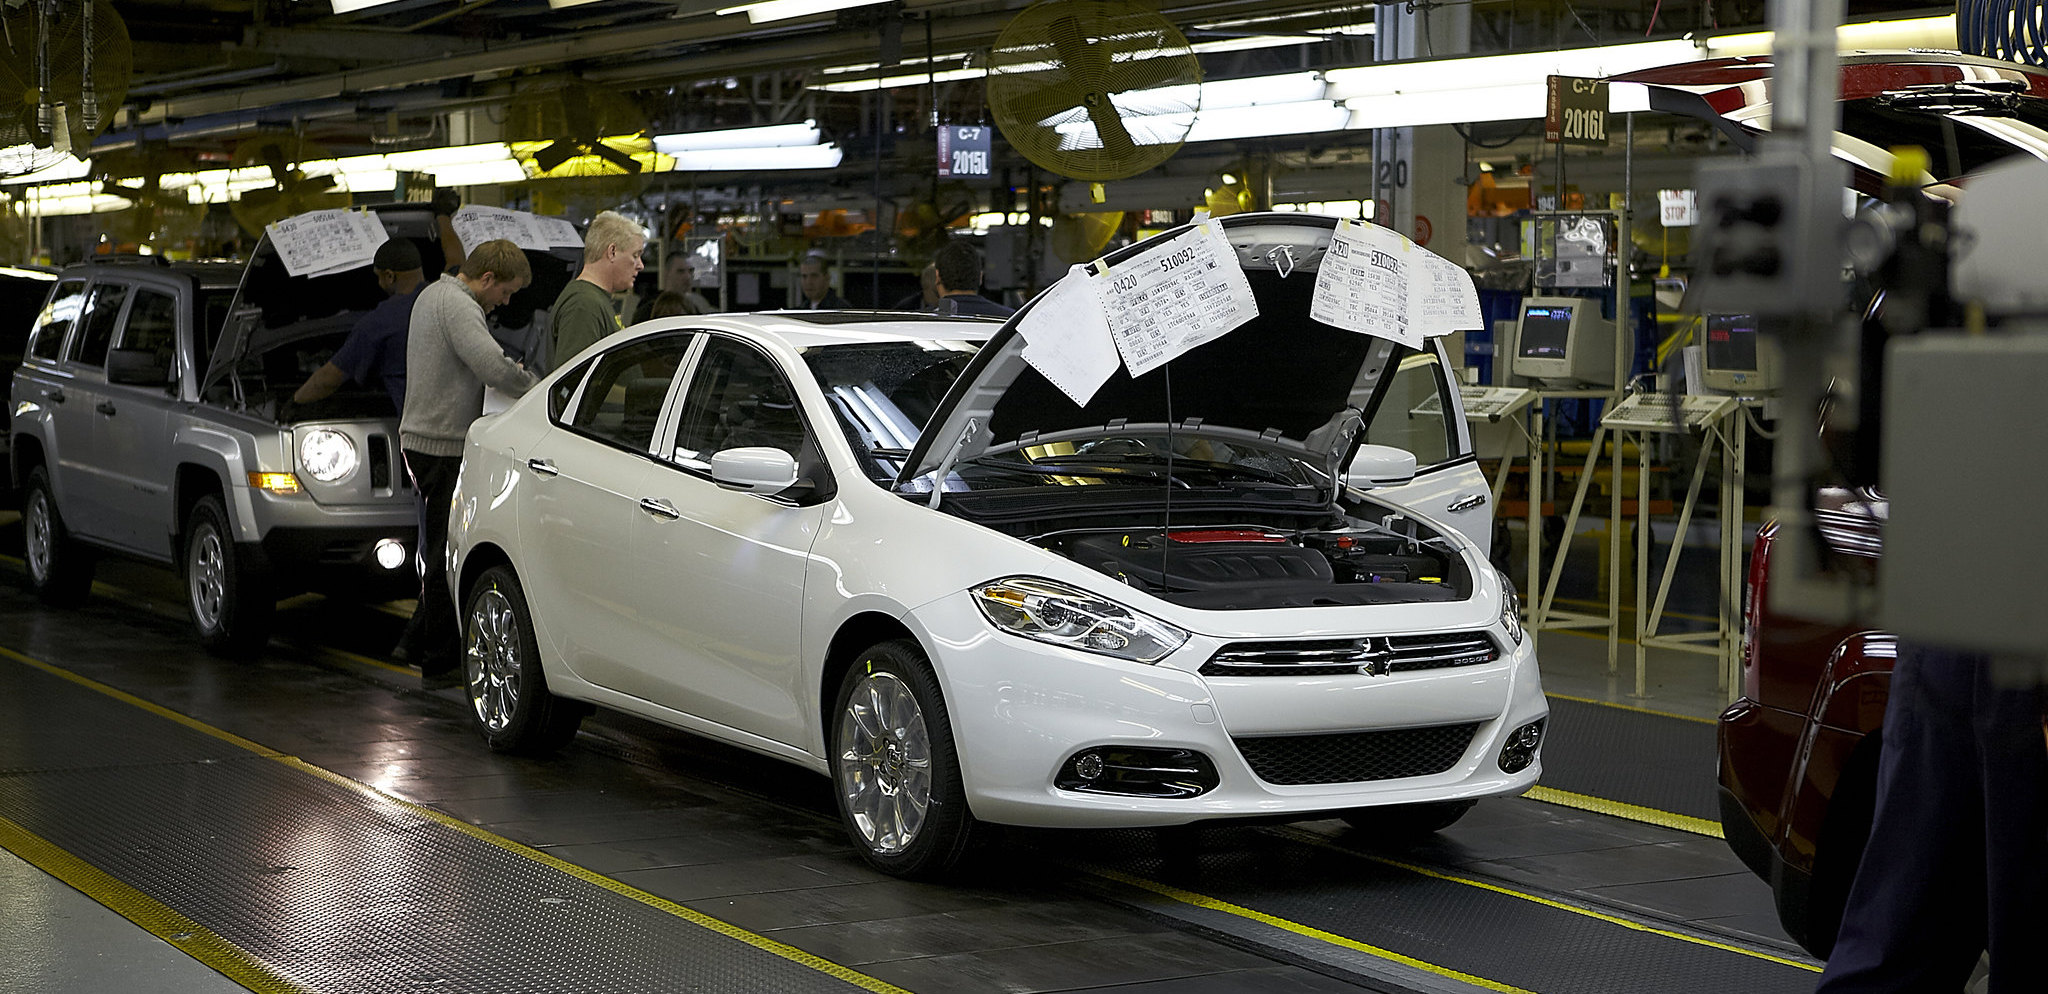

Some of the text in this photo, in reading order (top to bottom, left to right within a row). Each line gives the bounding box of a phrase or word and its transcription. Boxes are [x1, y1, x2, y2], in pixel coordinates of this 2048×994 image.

[1572, 78, 1597, 95] C-7
[1563, 107, 1606, 140] 2016L
[958, 128, 981, 140] C-7
[952, 150, 989, 175] 2015L
[1664, 206, 1686, 220] STOP
[1113, 274, 1138, 295] 0420
[1160, 246, 1196, 273] 510092
[1454, 655, 1489, 665] DODGE
